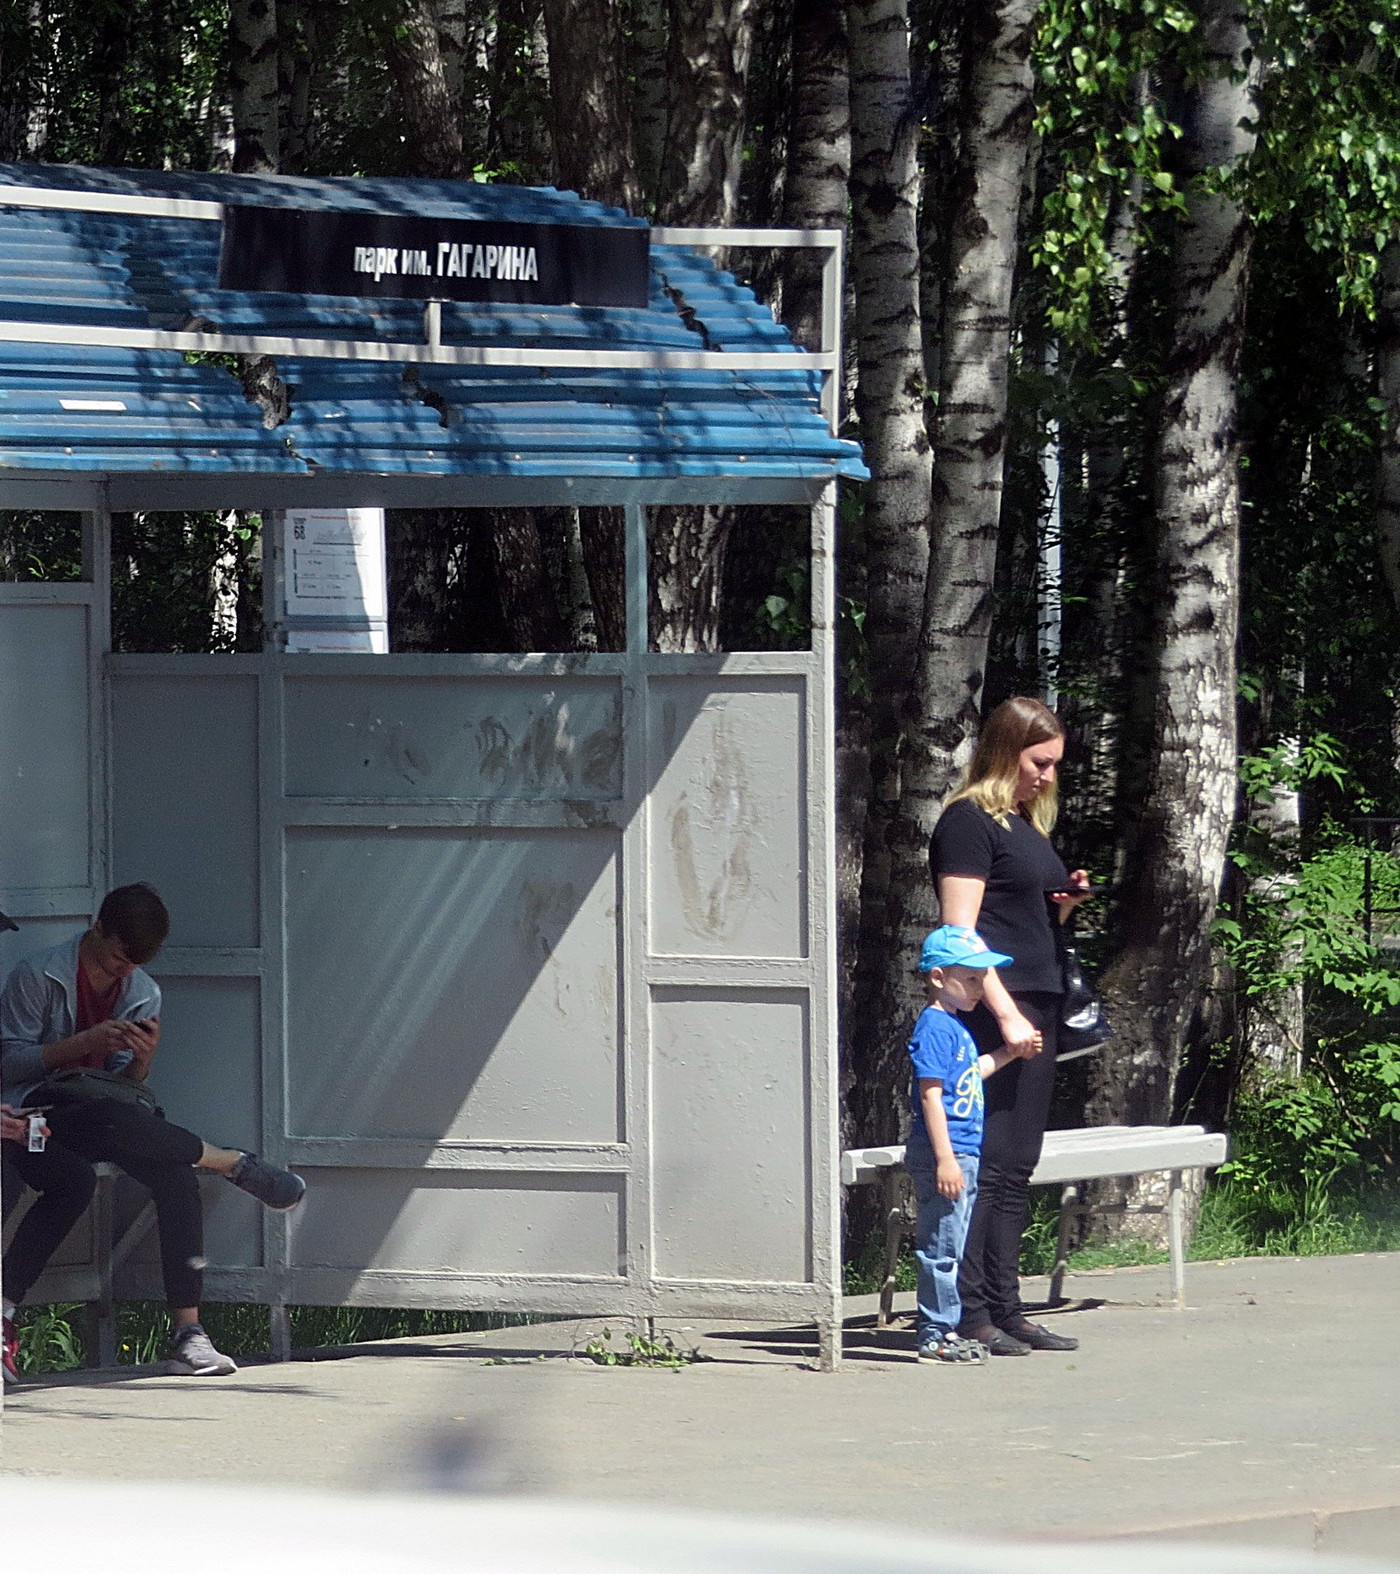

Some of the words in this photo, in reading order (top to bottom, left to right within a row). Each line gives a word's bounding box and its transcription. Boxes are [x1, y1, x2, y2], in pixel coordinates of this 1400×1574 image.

[354, 246, 398, 282] парк
[401, 249, 431, 276] им.
[436, 242, 539, 282] ГАГАРИНА
